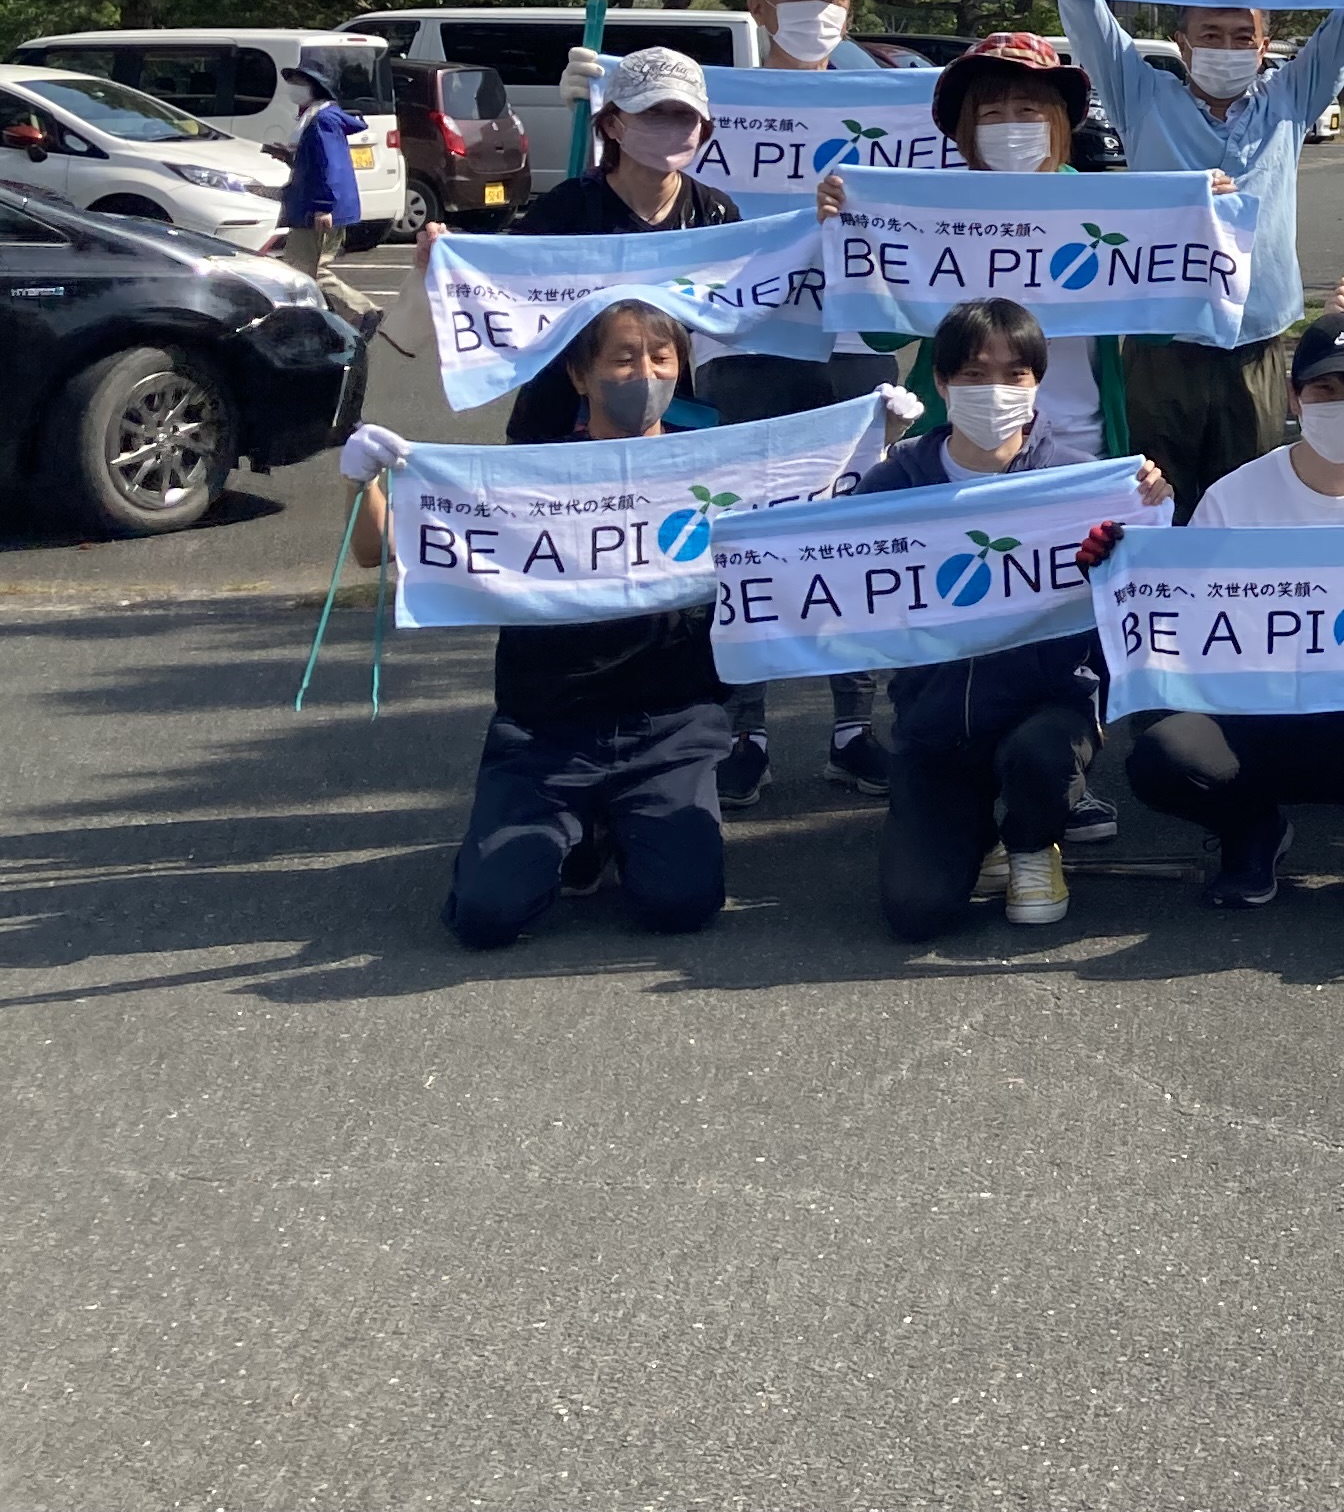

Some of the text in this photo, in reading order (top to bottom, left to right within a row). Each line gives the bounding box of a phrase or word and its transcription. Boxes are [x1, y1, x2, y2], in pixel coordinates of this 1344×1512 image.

[696, 139, 731, 176] A
[843, 237, 909, 285] BE
[929, 246, 966, 288] A
[453, 310, 518, 353] BE
[418, 524, 501, 575] BE
[522, 529, 566, 574] A
[714, 536, 927, 569] 待の先へ、次世代の笑顔へ
[800, 574, 842, 621] A
[864, 542, 1085, 615] PIONE
[1121, 610, 1180, 656] BE
[1202, 610, 1242, 656] A
